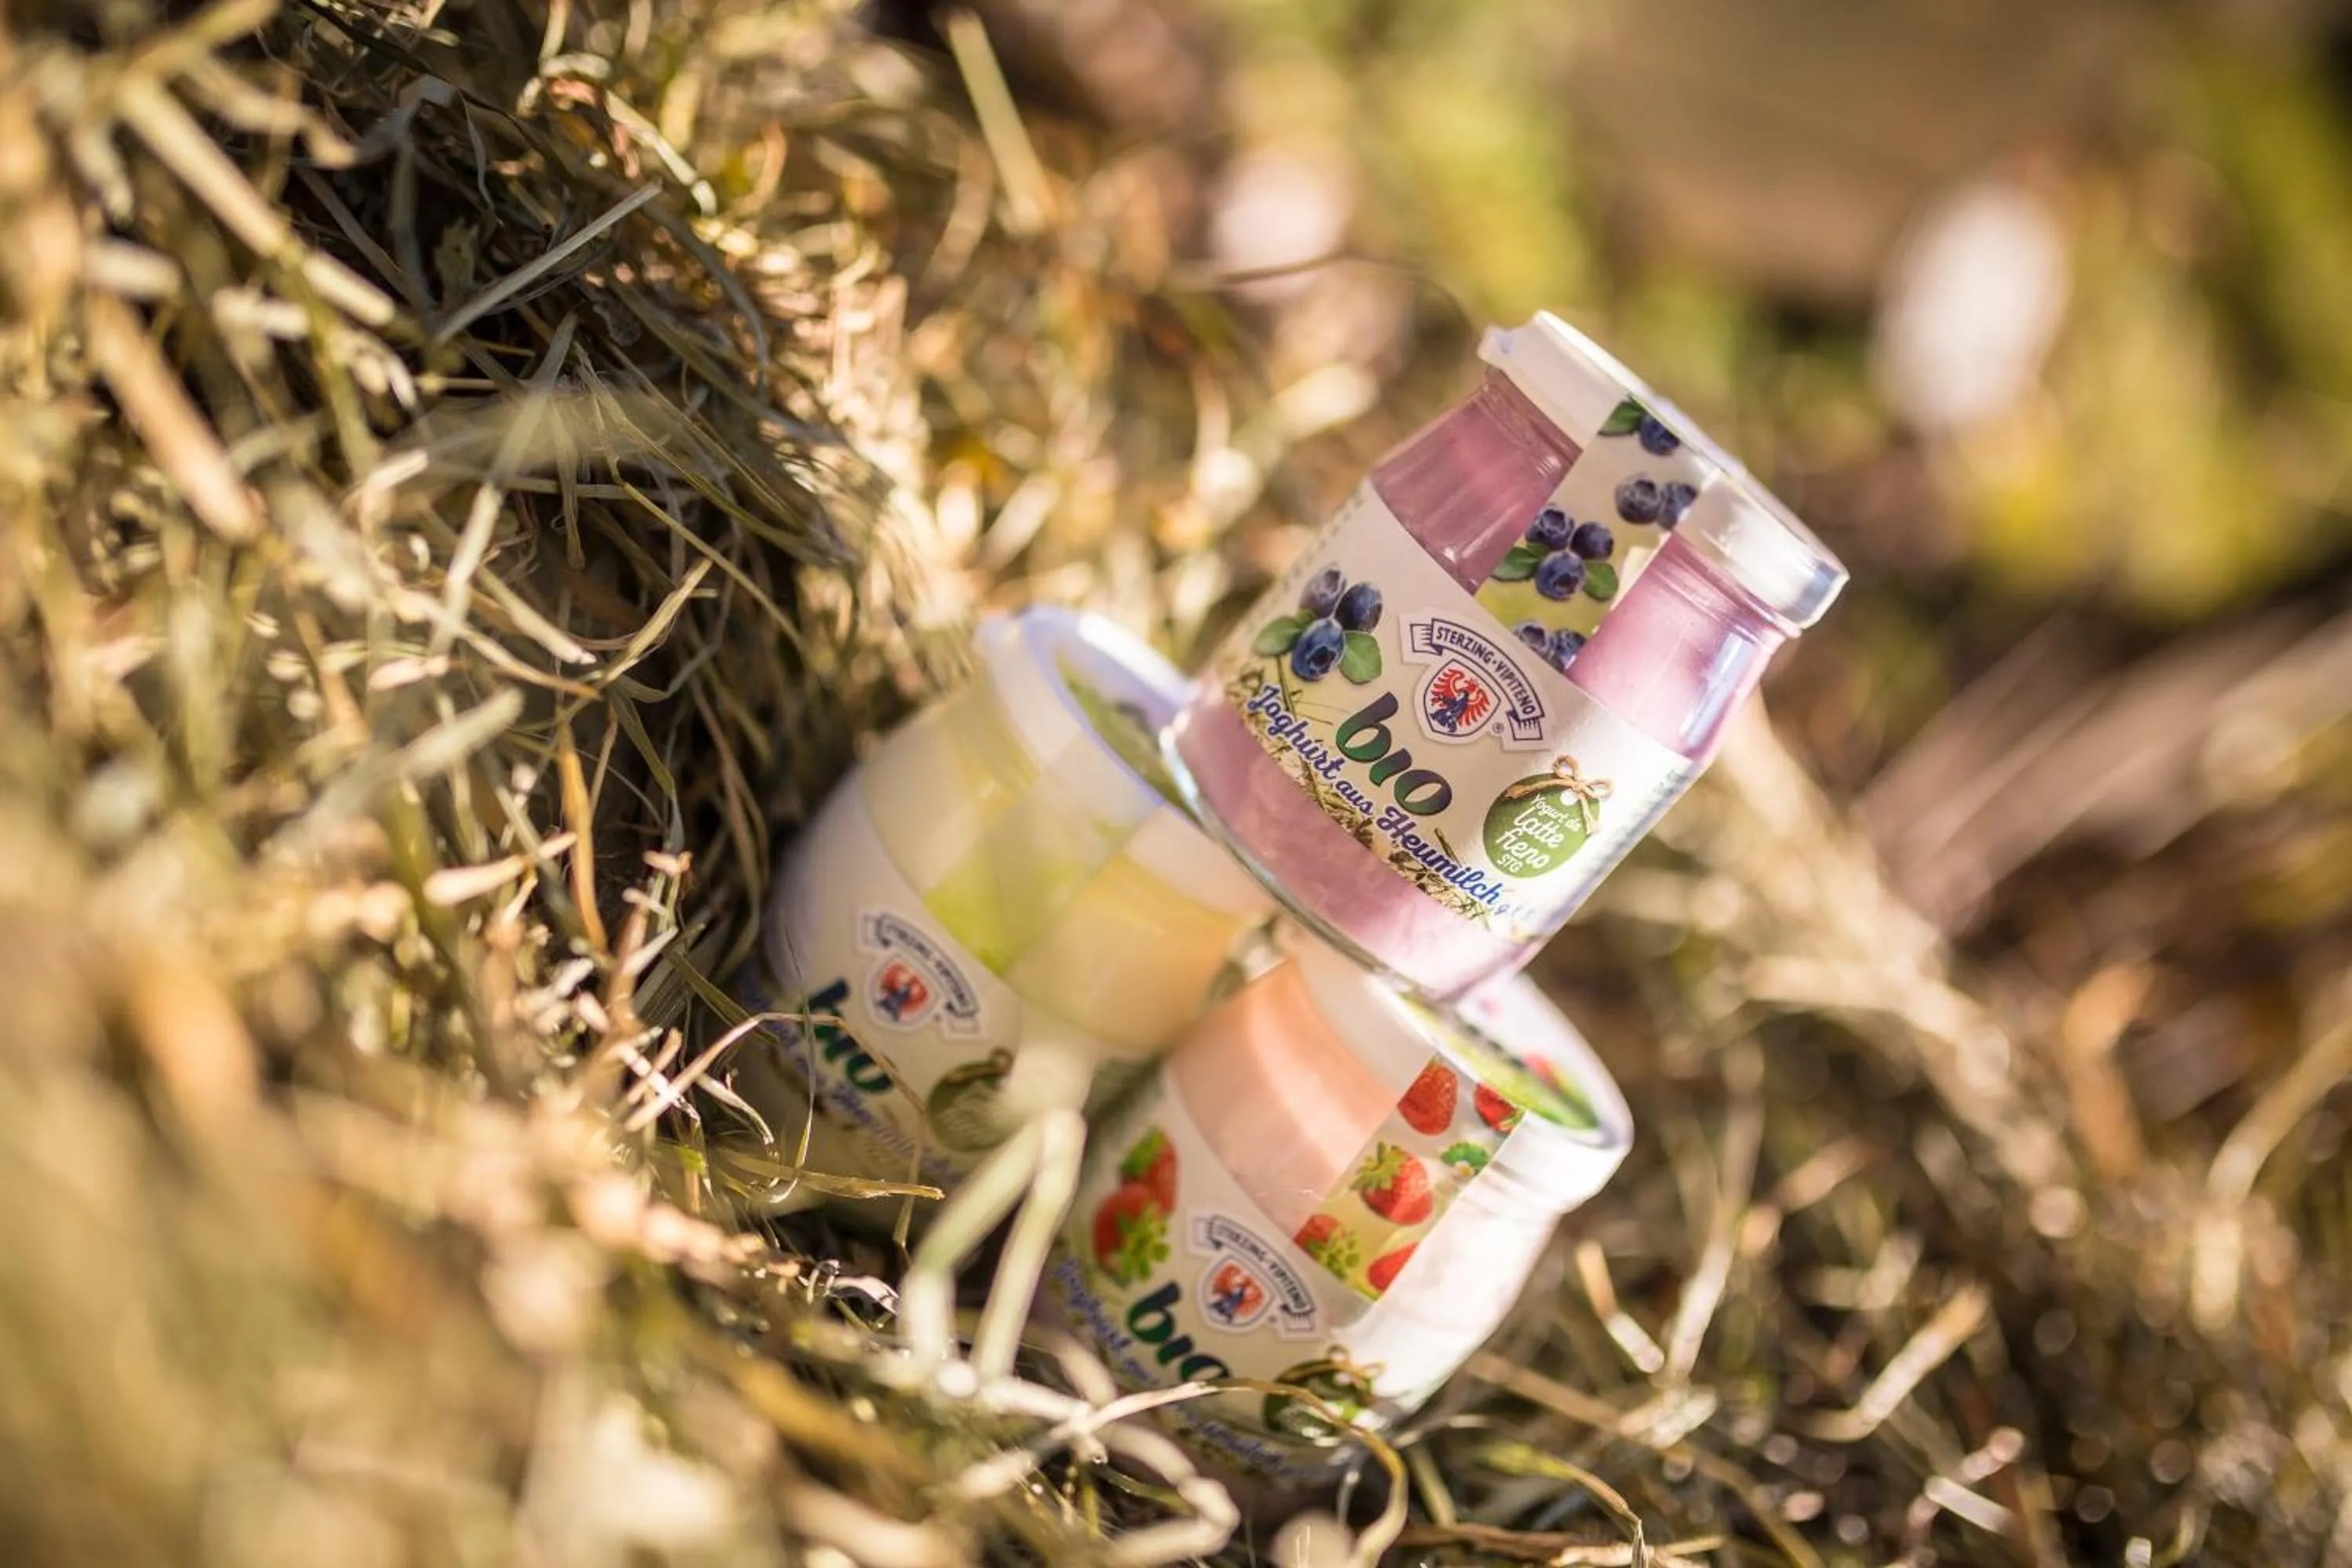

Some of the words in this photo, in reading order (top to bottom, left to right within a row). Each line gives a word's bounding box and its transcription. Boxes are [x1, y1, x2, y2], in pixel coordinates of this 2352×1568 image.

[1436, 626, 1493, 665] STERZING
[1494, 659, 1536, 714] VIPITENO
[1247, 684, 1345, 780] Joghurt
[1335, 780, 1374, 815] aus
[1376, 806, 1503, 904] Heumilch
[1336, 691, 1453, 816] bio
[1497, 854, 1523, 873] STG
[1127, 1279, 1232, 1385] bio
